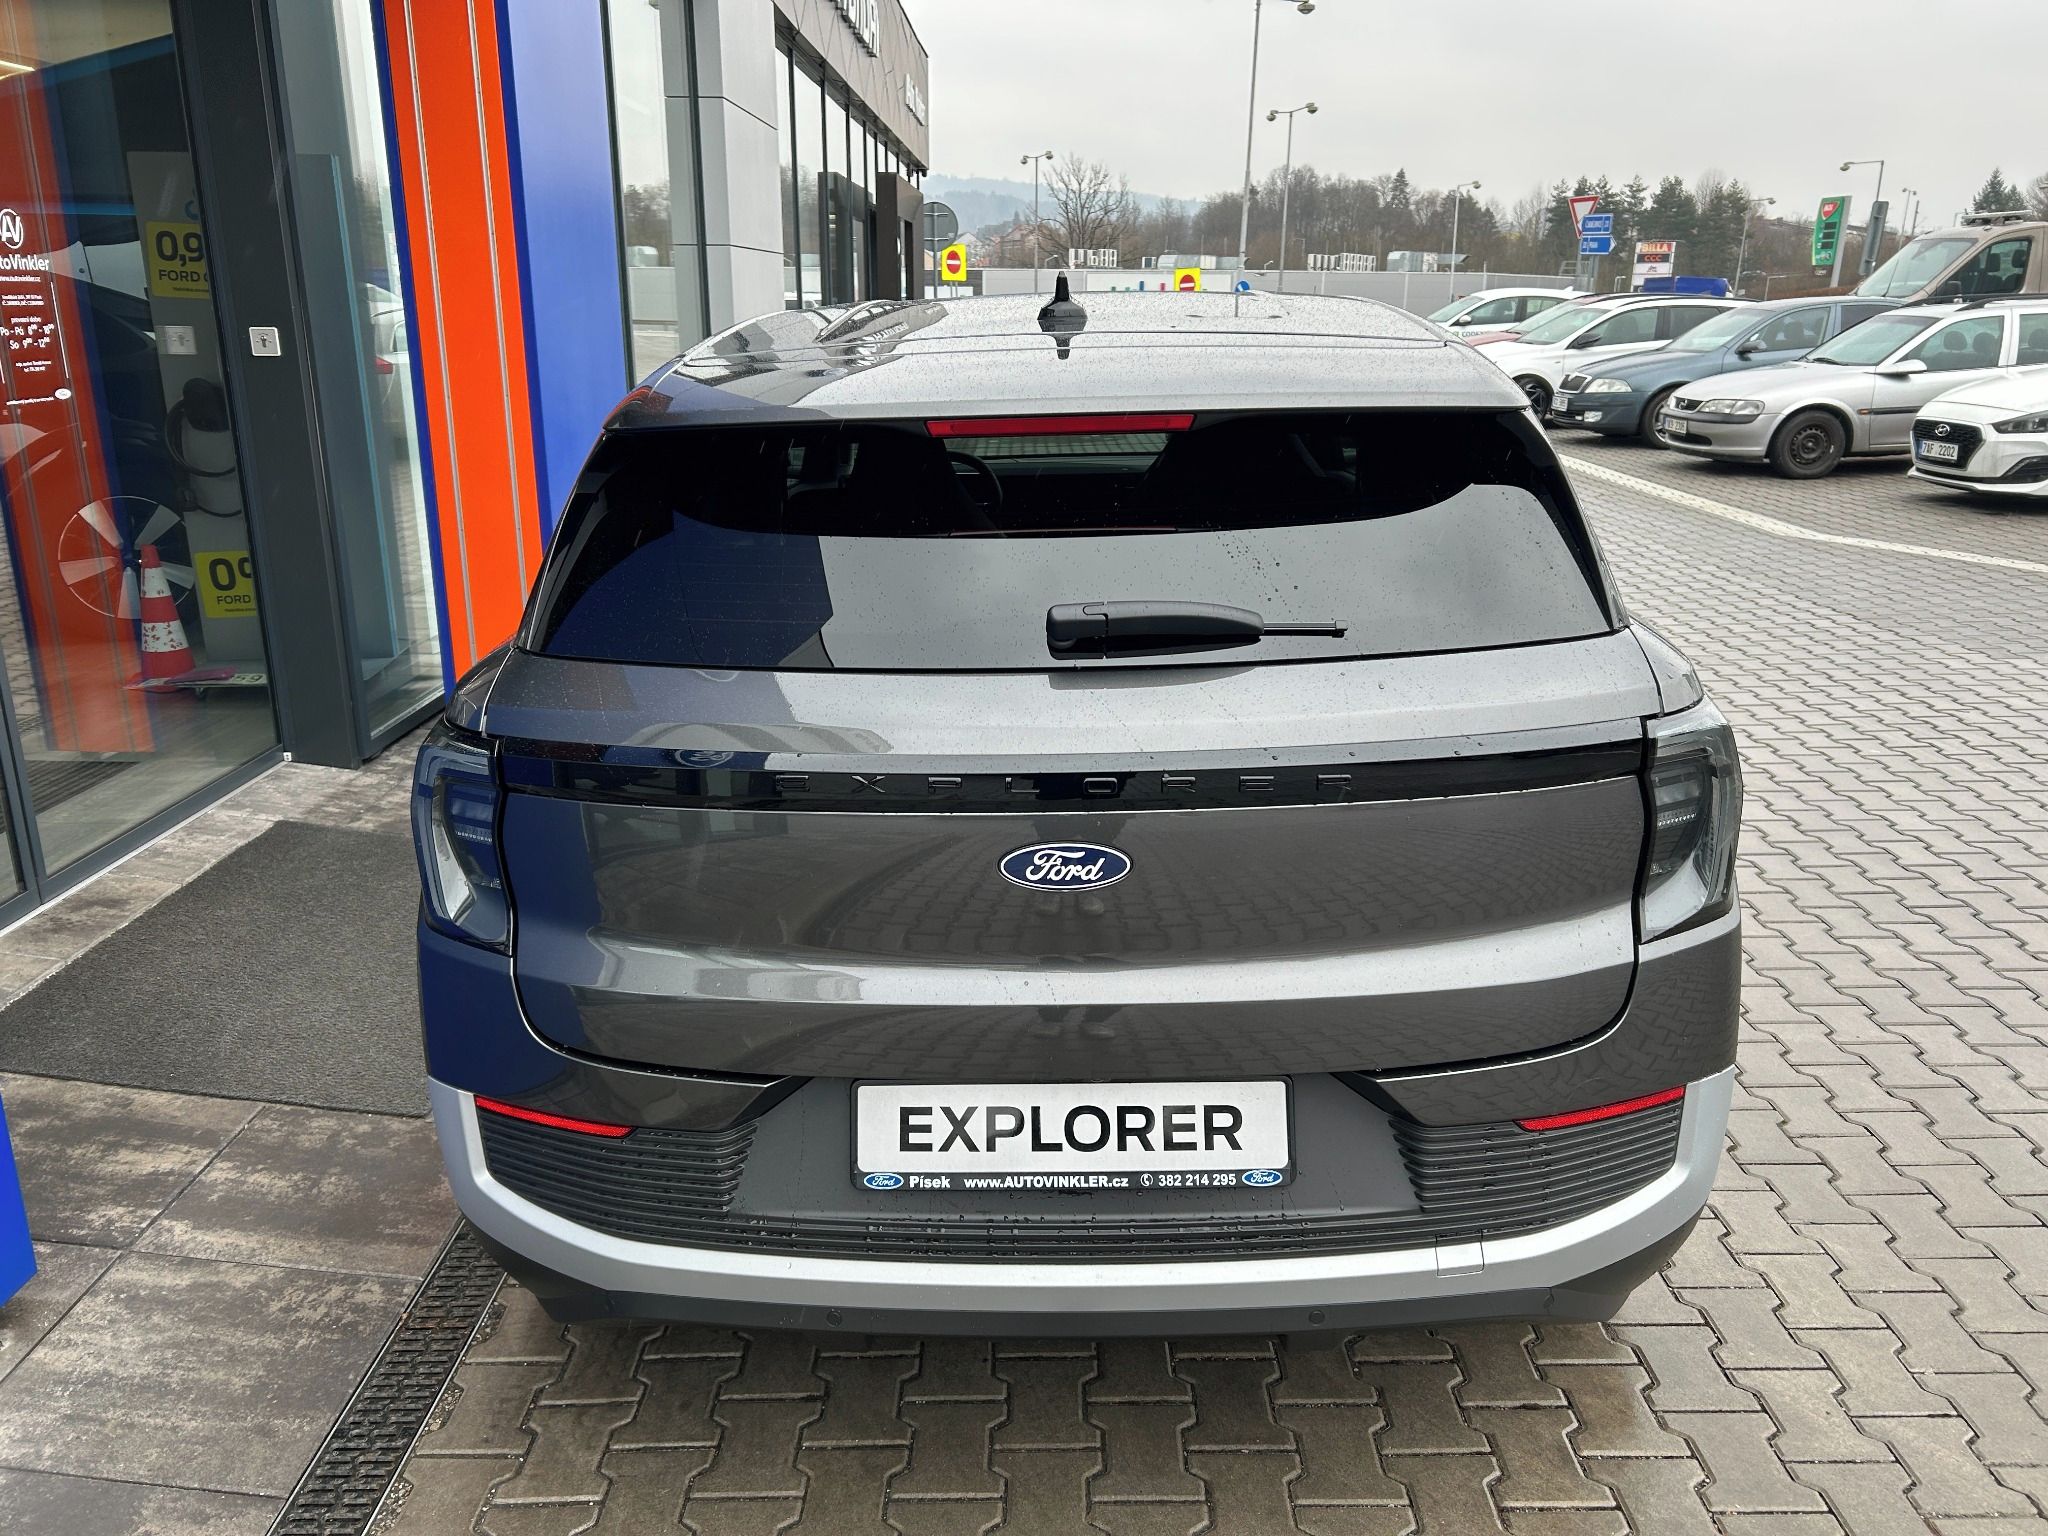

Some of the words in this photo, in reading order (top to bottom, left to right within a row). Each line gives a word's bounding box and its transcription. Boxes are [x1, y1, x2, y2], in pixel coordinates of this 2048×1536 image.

[1641, 243, 1668, 253] BILLA
[159, 269, 201, 282] FORD
[10, 339, 19, 349] So
[1922, 442, 1934, 455] 7AF
[1938, 444, 1956, 458] 2202
[216, 594, 251, 605] FORD
[775, 774, 1352, 794] EXPLORER
[899, 1104, 1243, 1153] EXPLORER
[908, 1175, 951, 1189] Písek
[963, 1175, 1129, 1189] www.AUTOVINKLER.cz
[1157, 1174, 1182, 1187] 382
[1185, 1173, 1210, 1187] 214
[1212, 1173, 1237, 1186] 295
